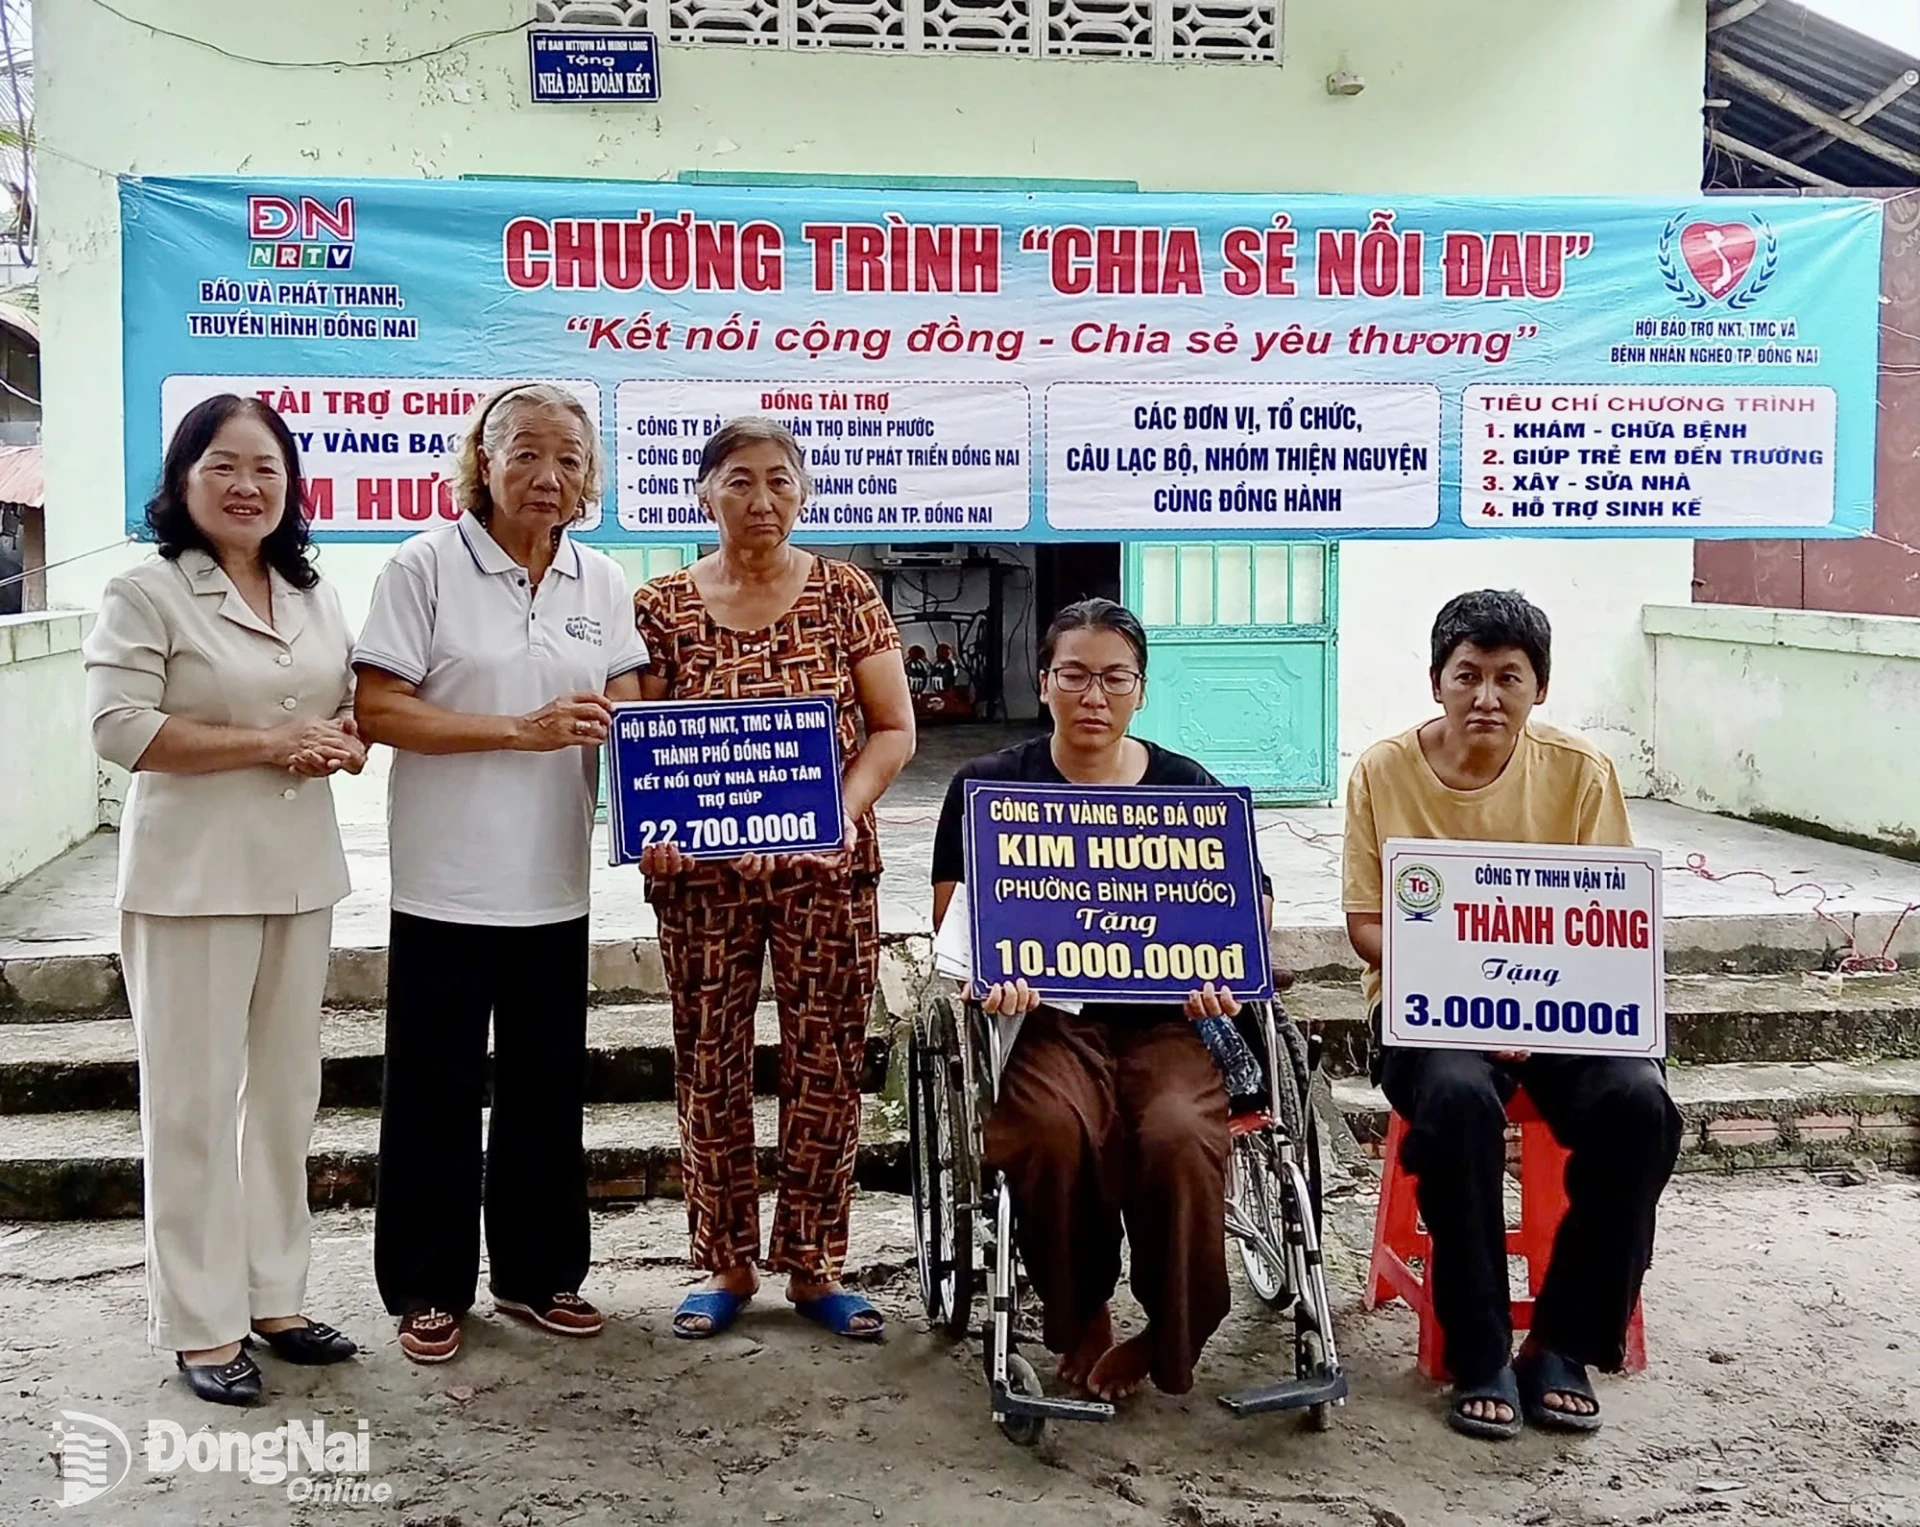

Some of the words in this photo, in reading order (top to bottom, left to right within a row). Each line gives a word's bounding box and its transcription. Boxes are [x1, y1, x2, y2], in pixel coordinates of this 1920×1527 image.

[538, 67, 565, 94] NHÀ
[567, 73, 589, 99] ĐẠI
[591, 68, 624, 94] ĐOÀN
[627, 63, 652, 94] KẾT
[250, 243, 353, 269] NRTV
[504, 211, 783, 293] CHƯƠNG
[804, 216, 1001, 293] TRÌNH
[1224, 214, 1296, 297] SẺ
[1318, 210, 1423, 297] NỖI
[201, 279, 240, 302] BÁO
[247, 280, 272, 304] VÀ
[278, 282, 328, 304] PHÁT
[333, 286, 404, 309] THANH,
[270, 312, 317, 336] HÌNH
[383, 318, 417, 338] NAI
[685, 312, 760, 352] nối
[774, 317, 892, 360] cộng
[905, 313, 1025, 361] đồng
[1071, 322, 1171, 355] Chia
[1185, 321, 1239, 356] sẻ
[1250, 324, 1330, 362] yêu
[1635, 316, 1657, 340] HỘI
[1749, 322, 1776, 337] TMC
[1611, 343, 1645, 366] BỆNH
[1796, 349, 1818, 363] NAI
[323, 389, 392, 420] TRỢ
[818, 389, 848, 411] TÀI
[854, 392, 889, 415] TRỢ
[1134, 401, 1176, 430] CÁC
[1184, 405, 1228, 430] ĐƠN
[1235, 406, 1260, 434] VỊ,
[1267, 397, 1294, 430] TỔ
[1300, 401, 1362, 432] CHỨC,
[1480, 393, 1542, 412] TIÊU
[1552, 394, 1599, 412] CHÍ
[1608, 396, 1725, 412] CHƯƠNG
[1734, 395, 1816, 412] TRÌNH
[323, 428, 399, 454] VÀNG
[637, 415, 678, 436] CÔNG
[682, 419, 699, 436] TY
[816, 420, 844, 441] THỌ
[848, 416, 882, 437] BÌNH
[886, 416, 935, 437] PHƯỚC
[1485, 423, 1505, 438] 1.
[1513, 420, 1586, 438] KHÁM
[1611, 420, 1675, 438] CHỮA
[1684, 420, 1747, 442] BỆNH
[638, 445, 678, 466] CÔNG
[844, 447, 864, 466] TƯ
[866, 445, 903, 466] PHÁT
[907, 442, 948, 466] TRIỂN
[995, 449, 1020, 466] NAI
[1066, 443, 1109, 471] CÂU
[1116, 448, 1156, 476] LẠC
[1163, 443, 1198, 475] BỘ,
[1205, 442, 1268, 471] NHÓM
[1276, 443, 1336, 476] THIỆN
[1343, 443, 1427, 476] NGUYỆN
[1482, 450, 1505, 465] 2.
[1513, 446, 1570, 464] GIÚP
[1577, 444, 1621, 464] TRẺ
[1630, 450, 1666, 464] EM
[1674, 444, 1721, 464] ĐẾN
[1730, 446, 1823, 464] TRƯỜNG
[638, 474, 678, 495] CÔNG
[858, 475, 897, 495] CÔNG
[1482, 476, 1505, 491] 3.
[1512, 473, 1560, 491] XÂY
[1585, 470, 1633, 491] SỬA
[1642, 473, 1691, 491] NHÀ
[1154, 484, 1212, 513] CÙNG
[1219, 481, 1277, 513] ĐỒNG
[1284, 484, 1342, 513] HÀNH
[1481, 502, 1503, 517] 4.
[1512, 496, 1544, 517] HỖ
[1552, 500, 1598, 520] TRỢ
[1606, 502, 1663, 517] SINH
[1672, 497, 1702, 516] KẾ
[639, 507, 663, 524] CHI
[833, 504, 873, 524] CÔNG
[877, 507, 897, 524] AN
[901, 507, 920, 523] TP.
[968, 507, 992, 523] NAI
[621, 717, 645, 742] HỘI
[648, 714, 677, 738] BẢO
[679, 716, 706, 739] TRỢ
[709, 716, 739, 735] NKT,
[741, 714, 772, 732] TMC
[774, 709, 793, 731] VÀ
[795, 711, 826, 729] BNN
[652, 744, 699, 766] THÀNH
[701, 738, 731, 763] PHỐ
[774, 740, 799, 759] NAI
[633, 772, 660, 791] KẾT
[664, 770, 690, 789] NỐI
[724, 767, 756, 785] NHÀ
[790, 764, 822, 780] TÂM
[697, 792, 725, 809] TRỢ
[729, 789, 763, 805] GIÚP
[990, 797, 1039, 822] CÔNG
[1043, 803, 1064, 823] TY
[1069, 800, 1118, 825] VÀNG
[1122, 805, 1159, 829] BẠC
[1163, 801, 1189, 825] ĐÁ
[1192, 801, 1228, 827] QUÝ
[998, 833, 1075, 867] KIM
[1088, 834, 1225, 870] HƯƠNG
[994, 877, 1091, 903] (PHƯỜNG
[1098, 879, 1148, 902] BÌNH
[1155, 881, 1236, 907] PHƯỚC)
[1475, 864, 1512, 886] CÔNG
[1515, 869, 1530, 886] TY
[1534, 869, 1570, 888] TNHH
[1574, 867, 1600, 893] VẬN
[1604, 866, 1626, 890] TẢI
[1076, 908, 1157, 938] Tặng
[1453, 896, 1554, 945] THÀNH
[1564, 900, 1649, 949] CÔNG
[995, 939, 1245, 980] 10.000.000đ
[1481, 958, 1562, 987] Tặng
[1404, 993, 1640, 1036] 3.000.000đ
